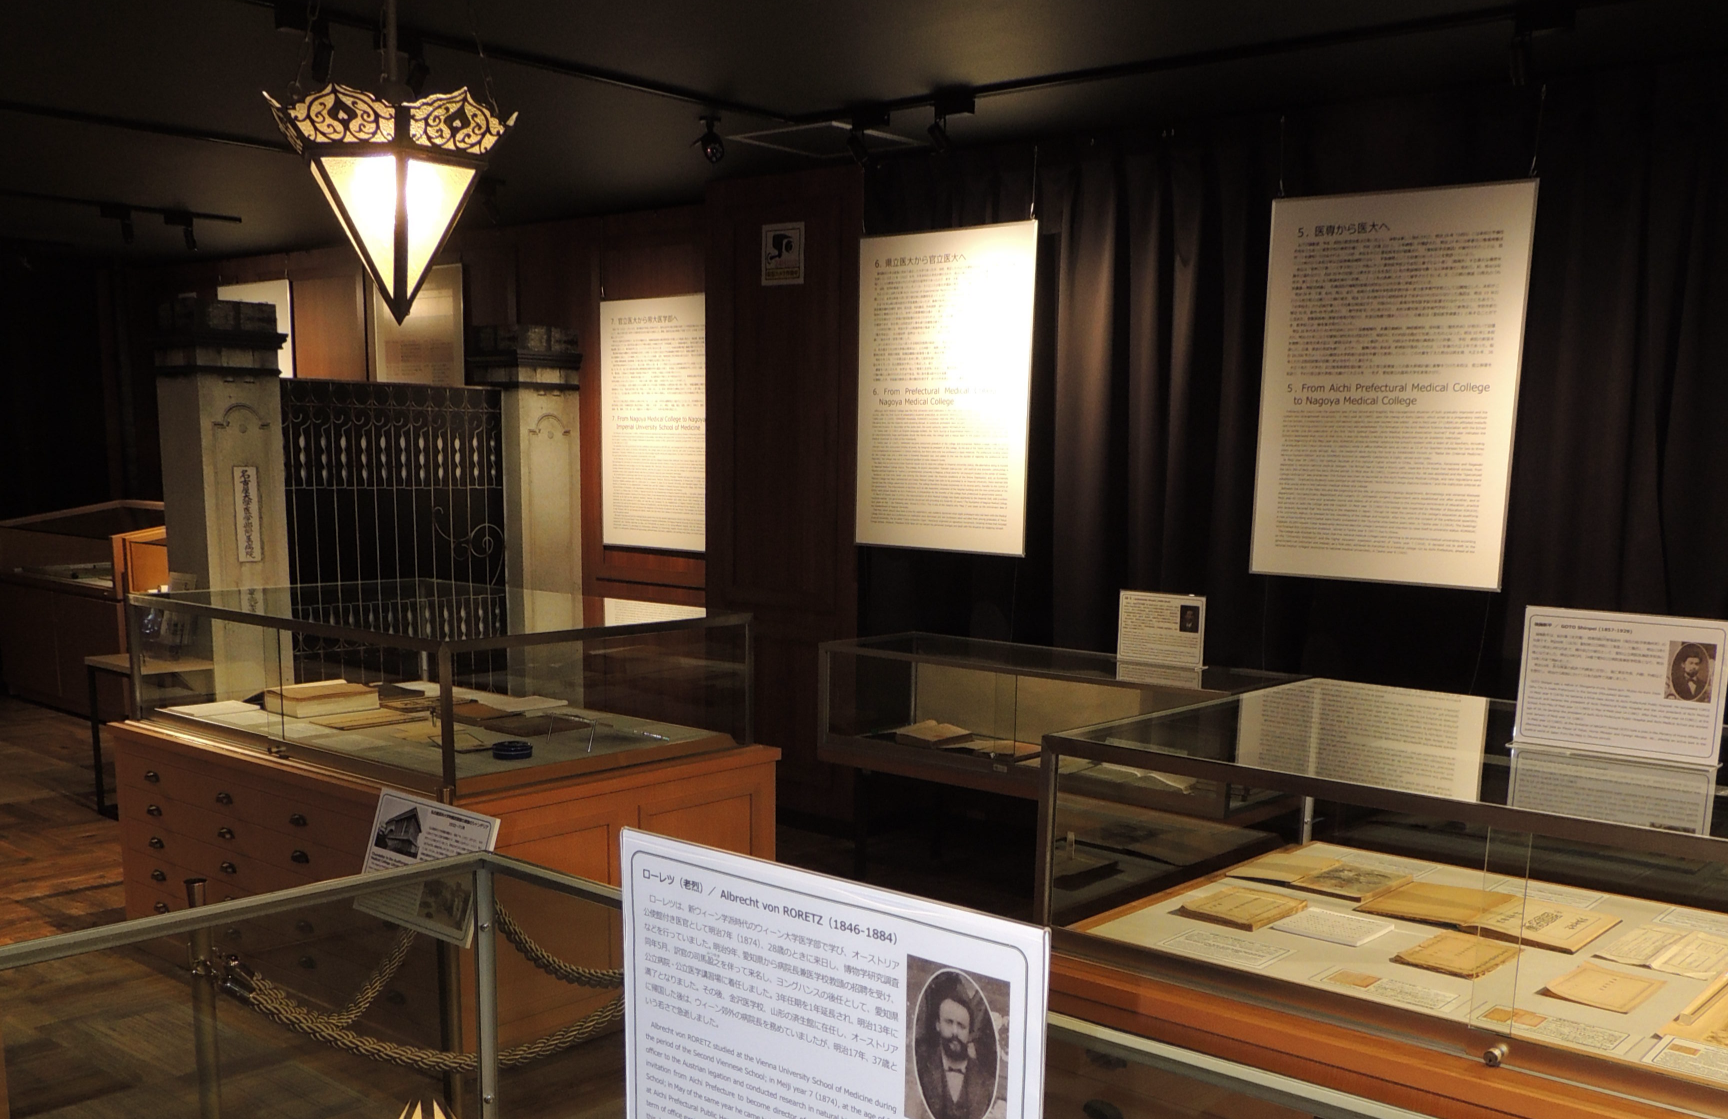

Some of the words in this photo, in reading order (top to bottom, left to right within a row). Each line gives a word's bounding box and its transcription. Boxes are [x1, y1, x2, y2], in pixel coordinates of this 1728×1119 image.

[1315, 222, 1390, 237] 医専から医大へ
[885, 254, 967, 268] 県立医大から官立医大へ
[905, 387, 940, 395] Prefectural
[945, 387, 970, 395] Medical
[1287, 384, 1298, 393] 5.
[1302, 384, 1325, 392] From
[1329, 383, 1352, 392] Aichi
[1356, 383, 1407, 392] Prefectural
[1412, 383, 1448, 392] Medical
[1452, 383, 1490, 395] College
[879, 398, 903, 407] Nagoya
[930, 398, 954, 406] College
[1294, 397, 1302, 405] to
[1305, 396, 1340, 408] Nagoya
[1344, 396, 1378, 406] Medical
[1382, 396, 1417, 407] College
[719, 888, 759, 909] Albrecht
[762, 901, 780, 914] von
[782, 905, 824, 927] RORETZ
[645, 1032, 655, 1043] the
[655, 1037, 674, 1049] period
[674, 1043, 682, 1051] of
[681, 1045, 692, 1056] the
[692, 1049, 715, 1064] Second
[715, 1057, 744, 1074] Viennese
[744, 1066, 768, 1083] School;
[768, 1076, 776, 1085] in
[776, 1078, 792, 1092] Meiji
[792, 1085, 808, 1096] year
[814, 1091, 841, 1109] (1874),
[841, 1103, 849, 1112] at
[850, 1105, 862, 1116] the
[650, 1021, 675, 1036] Albrecht
[674, 1030, 686, 1039] von
[687, 1033, 712, 1049] RORETZ
[712, 1043, 735, 1057] studied
[735, 1051, 743, 1059] at
[743, 1053, 755, 1063] the
[755, 1056, 777, 1071] Vienna
[778, 1064, 811, 1084] University
[811, 1076, 834, 1091] School
[834, 1085, 843, 1094] of
[843, 1087, 874, 1105] Medicine
[874, 1098, 898, 1115] during
[645, 1046, 664, 1058] officer
[663, 1052, 671, 1061] to
[671, 1055, 682, 1065] the
[681, 1059, 707, 1074] Austrian
[707, 1067, 732, 1083] legation
[732, 1078, 745, 1088] and
[745, 1083, 778, 1100] conducted
[778, 1095, 807, 1110] research
[807, 1104, 815, 1113] in
[645, 1059, 672, 1075] invitation
[673, 1069, 688, 1081] from
[688, 1075, 703, 1087] Aichi
[704, 1080, 736, 1099] Prefecture
[737, 1093, 745, 1102] to
[745, 1095, 771, 1112] become
[645, 1072, 667, 1088] School;
[667, 1080, 674, 1089] in
[673, 1083, 686, 1095] May
[686, 1088, 693, 1096] of
[692, 1091, 703, 1101] the
[703, 1095, 720, 1107] same
[720, 1102, 735, 1112] year
[734, 1105, 743, 1115] he
[653, 1089, 667, 1100] Aichi
[668, 1094, 699, 1112] Prefectural
[700, 1106, 717, 1119] Public
[646, 1100, 660, 1111] term
